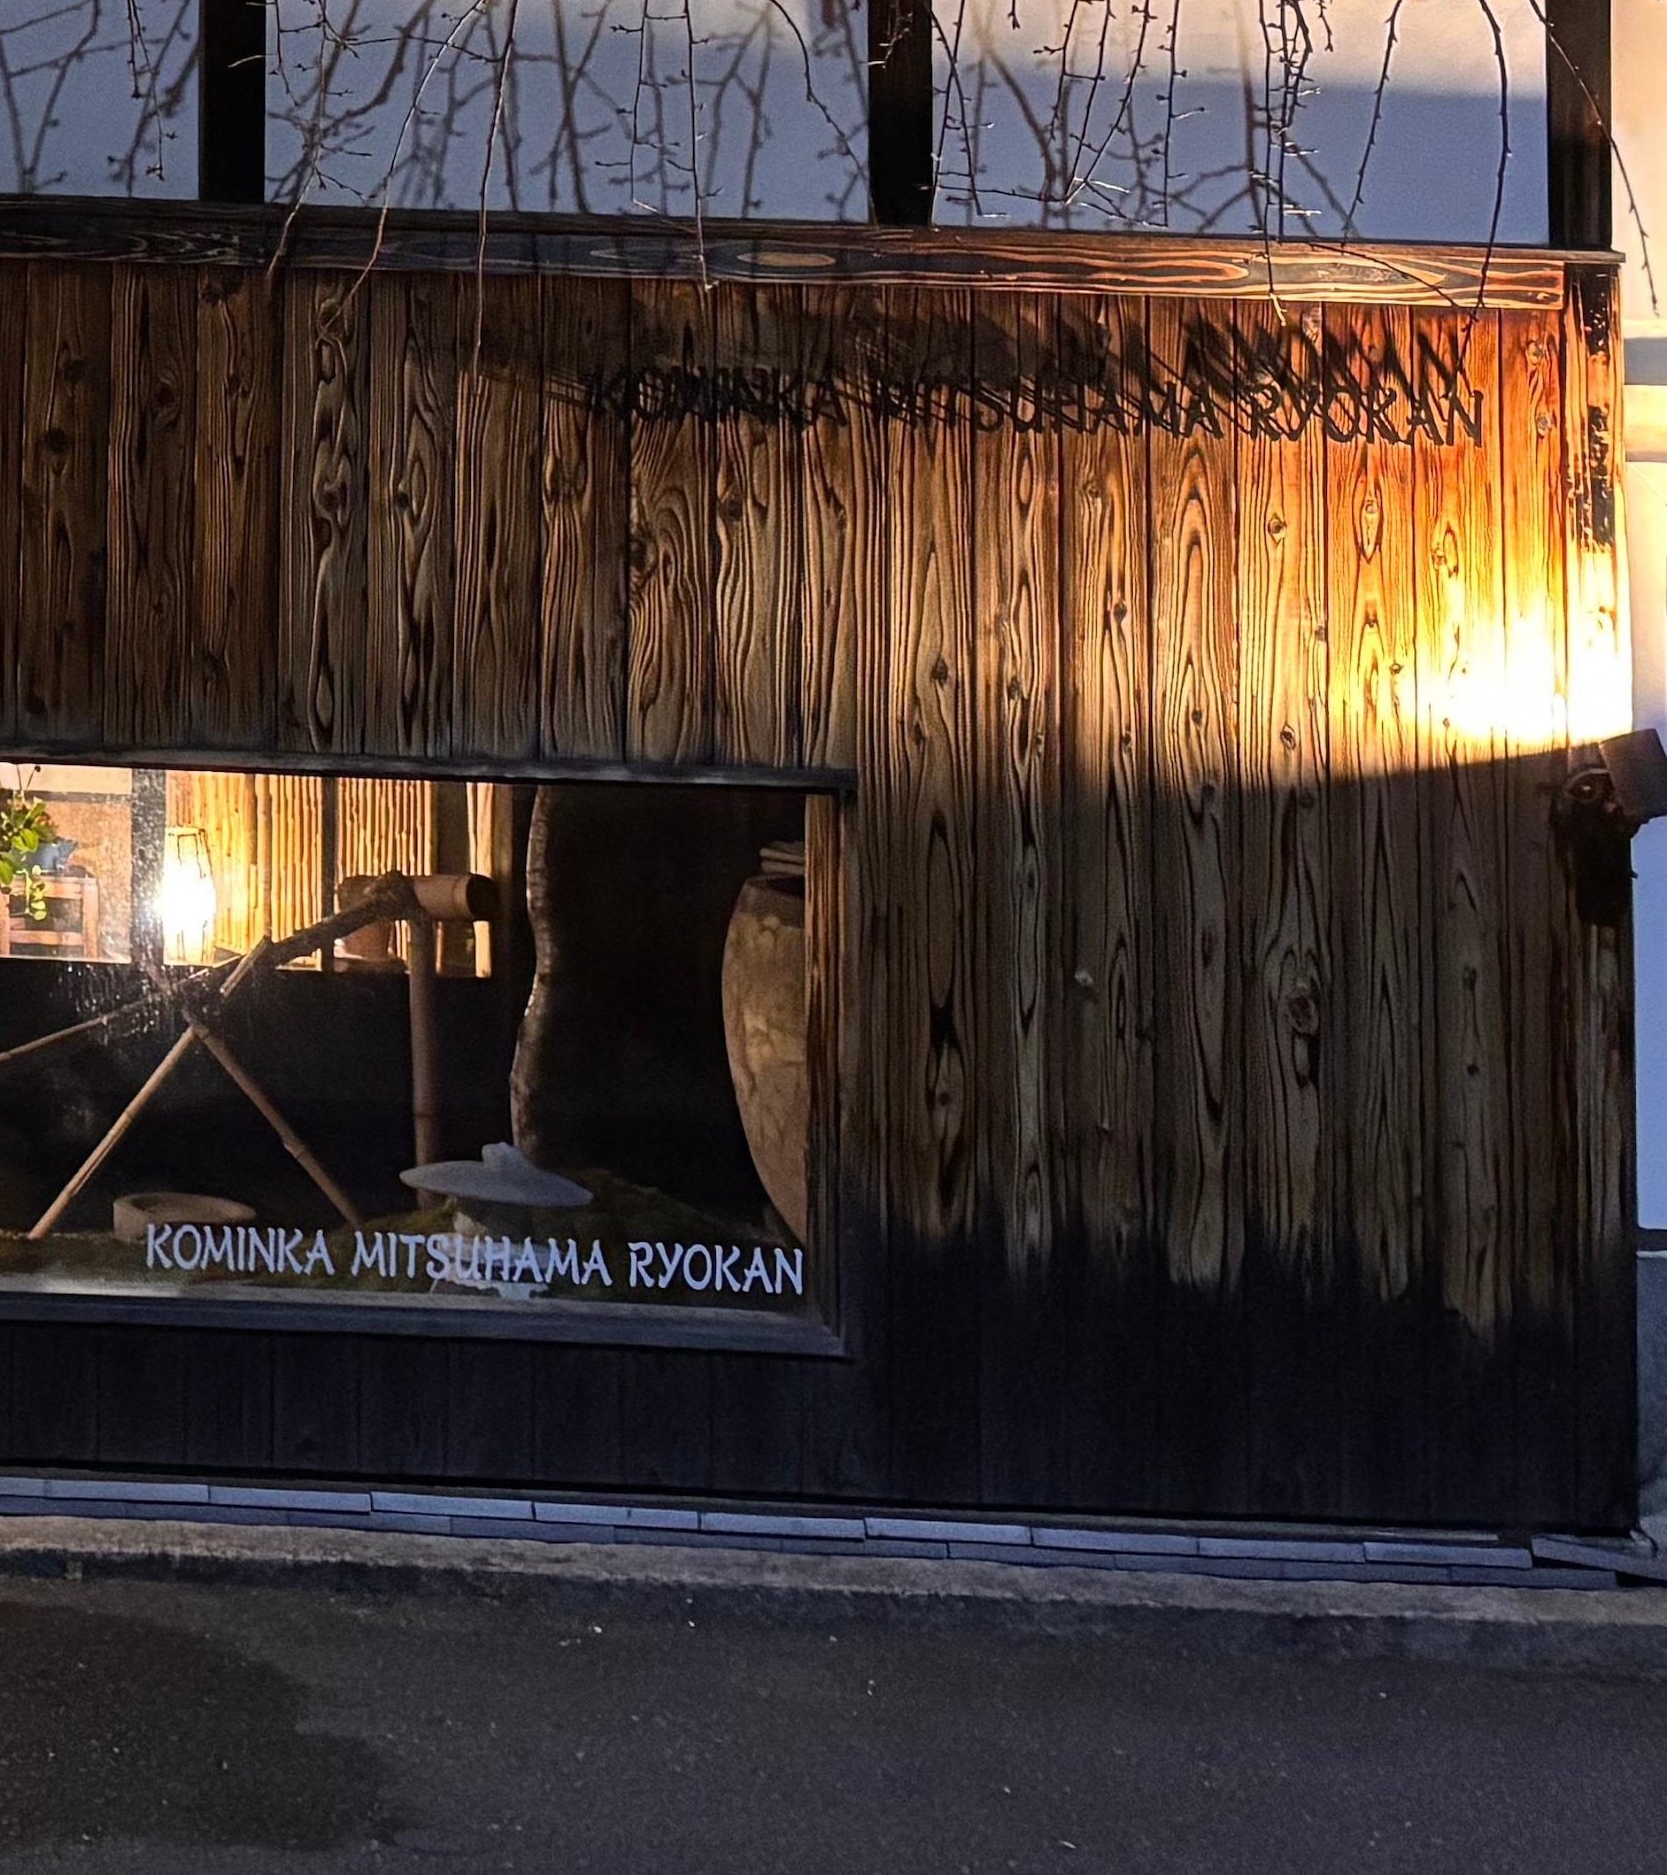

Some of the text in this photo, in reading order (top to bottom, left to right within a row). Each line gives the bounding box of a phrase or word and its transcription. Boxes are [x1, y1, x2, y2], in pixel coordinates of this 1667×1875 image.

[1246, 377, 1484, 448] RYOKAN
[145, 1222, 804, 1296] KOMINKA MITSUHAMA RYOKAN
